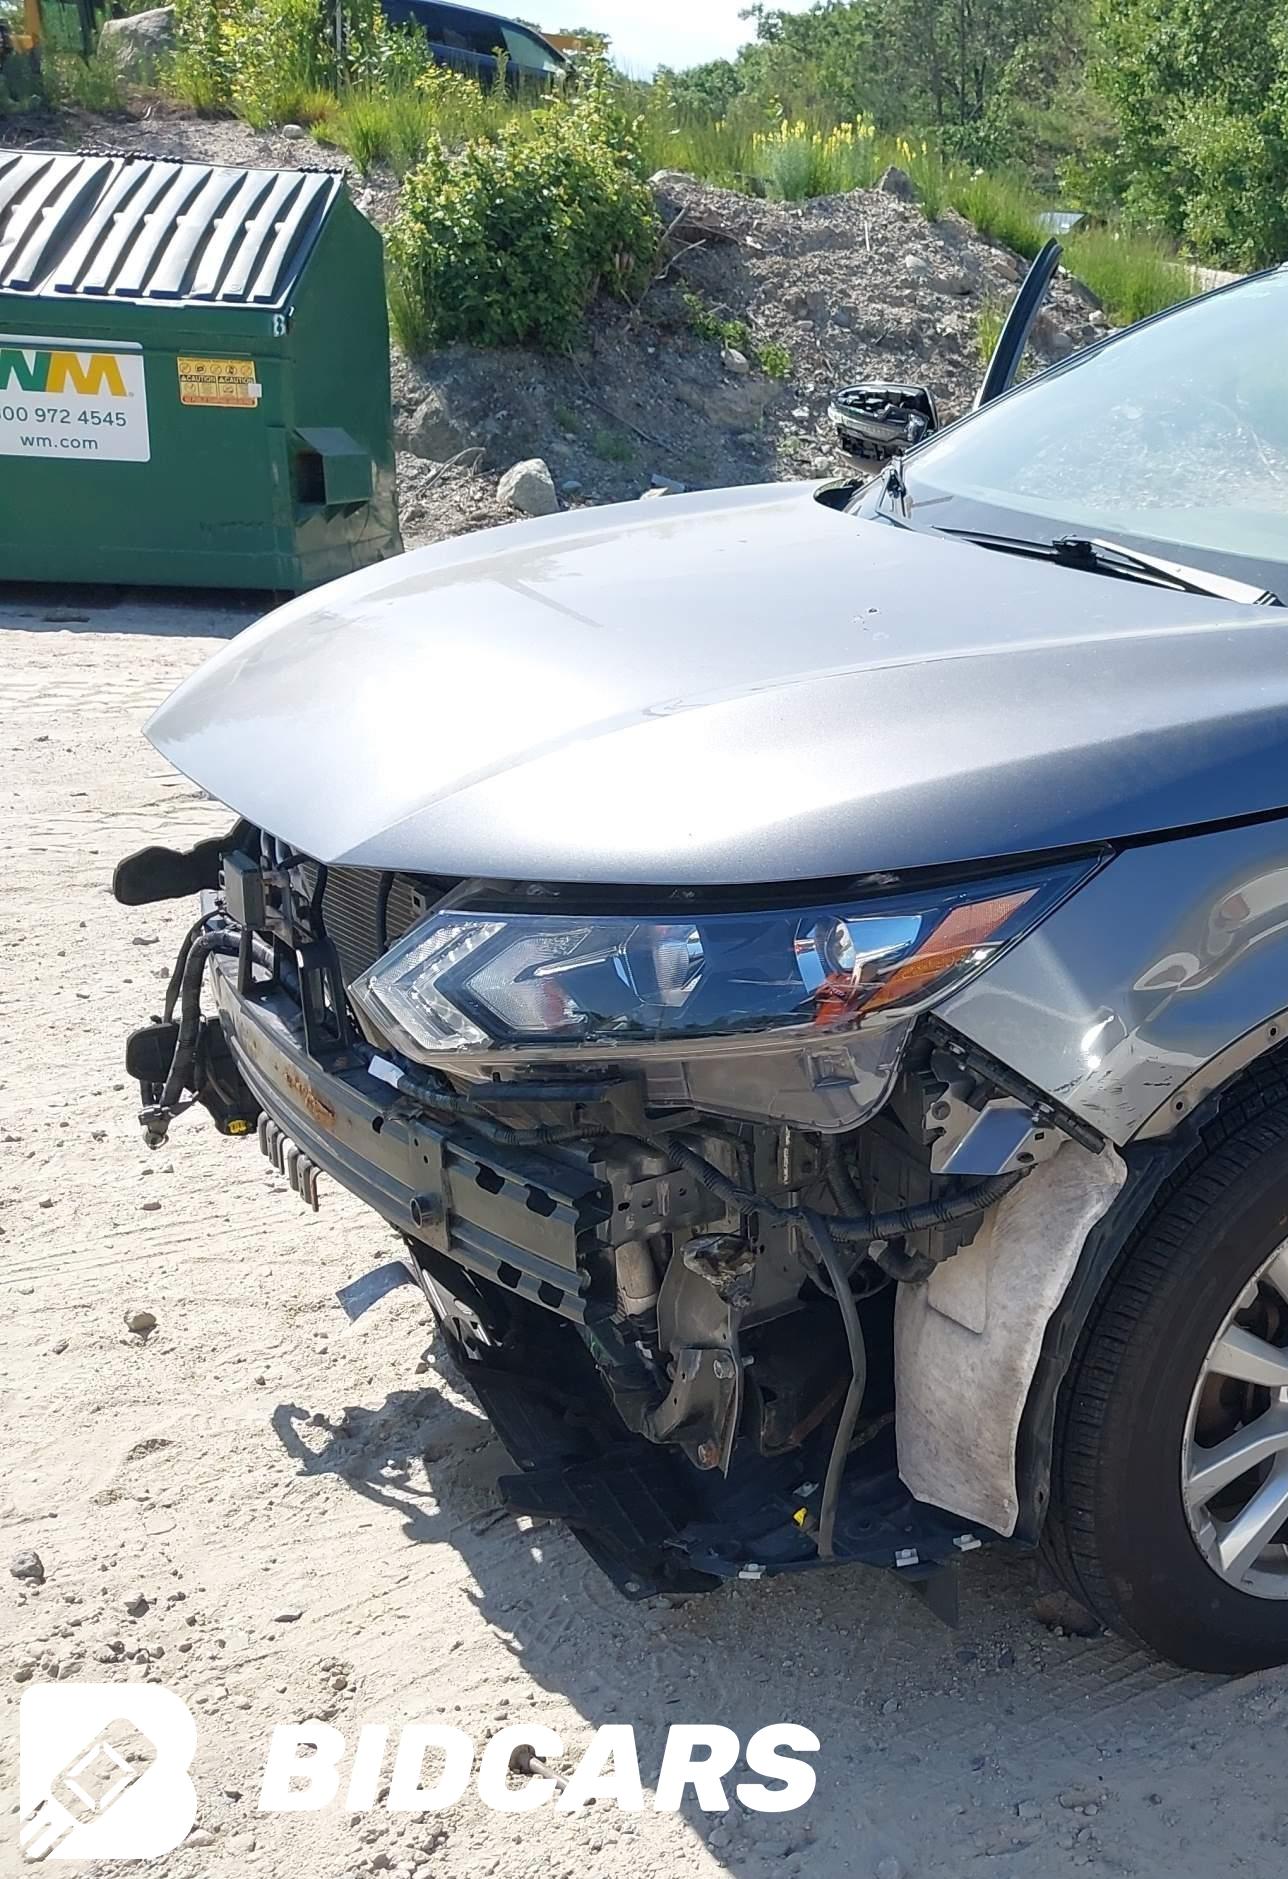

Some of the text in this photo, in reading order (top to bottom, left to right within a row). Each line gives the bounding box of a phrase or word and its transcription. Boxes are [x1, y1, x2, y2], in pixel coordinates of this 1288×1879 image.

[186, 375, 216, 383] CAUTION
[0, 406, 127, 427] 00 972 4545
[20, 435, 98, 450] wm.com
